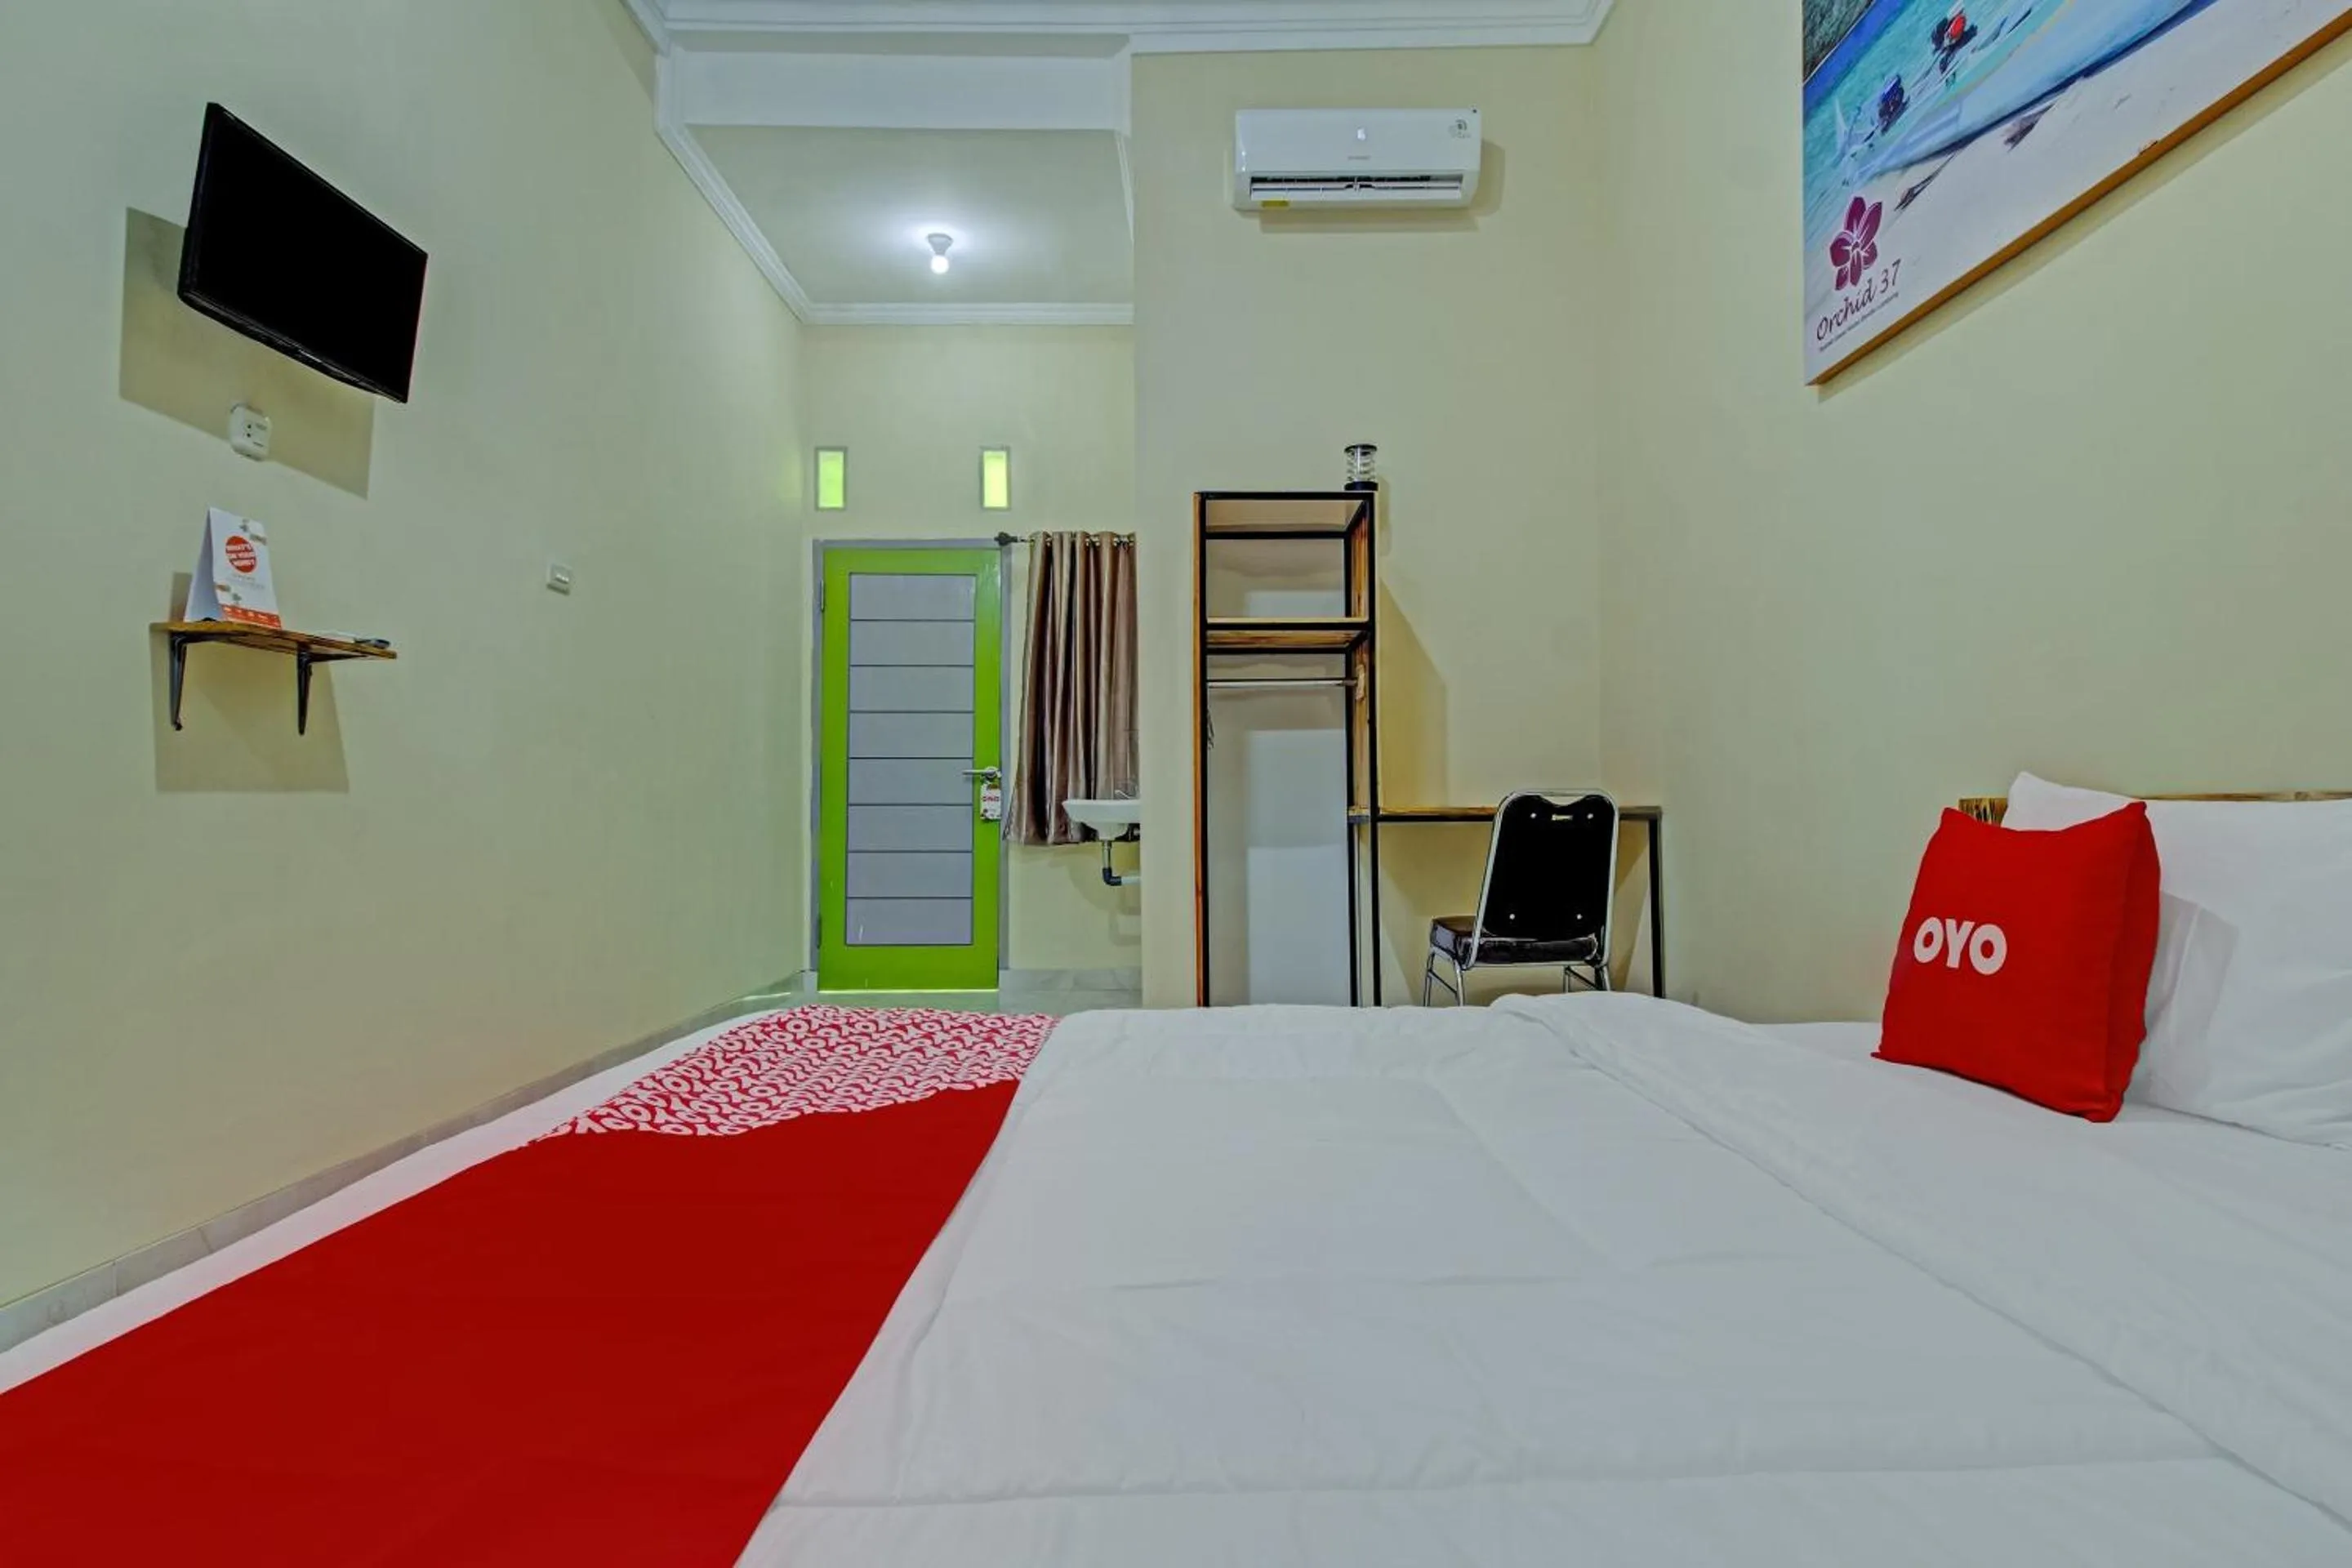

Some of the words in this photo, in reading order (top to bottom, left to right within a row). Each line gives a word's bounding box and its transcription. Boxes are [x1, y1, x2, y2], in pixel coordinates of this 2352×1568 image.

[1817, 278, 1878, 341] Orchid
[1880, 258, 1901, 294] 37
[1913, 916, 2007, 975] OYO
